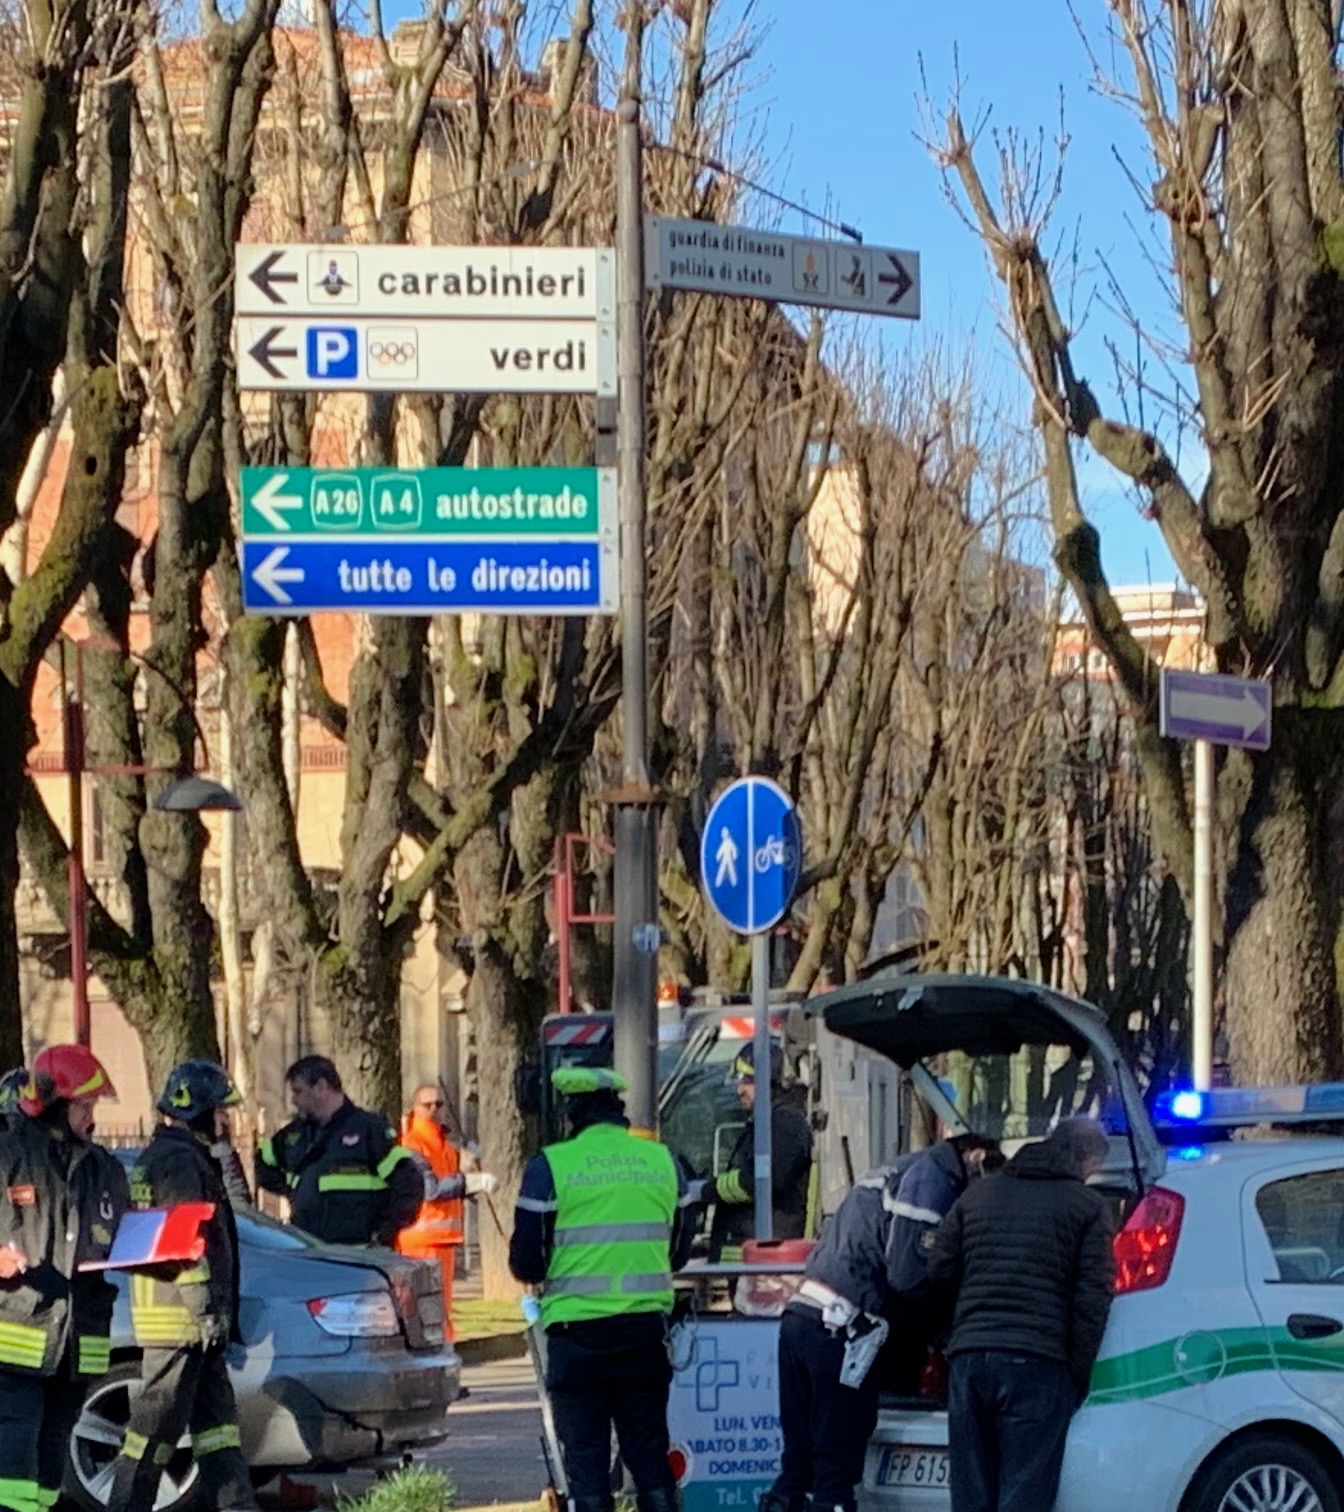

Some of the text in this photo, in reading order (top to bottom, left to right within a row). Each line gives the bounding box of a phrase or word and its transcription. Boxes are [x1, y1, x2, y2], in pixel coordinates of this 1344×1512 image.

[669, 228, 785, 258] guardia di finanza
[377, 265, 586, 297] carabinieri
[669, 257, 772, 285] polizia di stato
[316, 331, 586, 376] P verdi
[435, 485, 589, 519] autostrade
[338, 557, 592, 592] tutte le direzioni
[585, 1153, 648, 1168] Polizia
[714, 1416, 747, 1432] LUN.
[687, 1438, 736, 1454] ABATO
[708, 1459, 780, 1475] DOMENIC
[716, 1487, 747, 1505] Tel.
